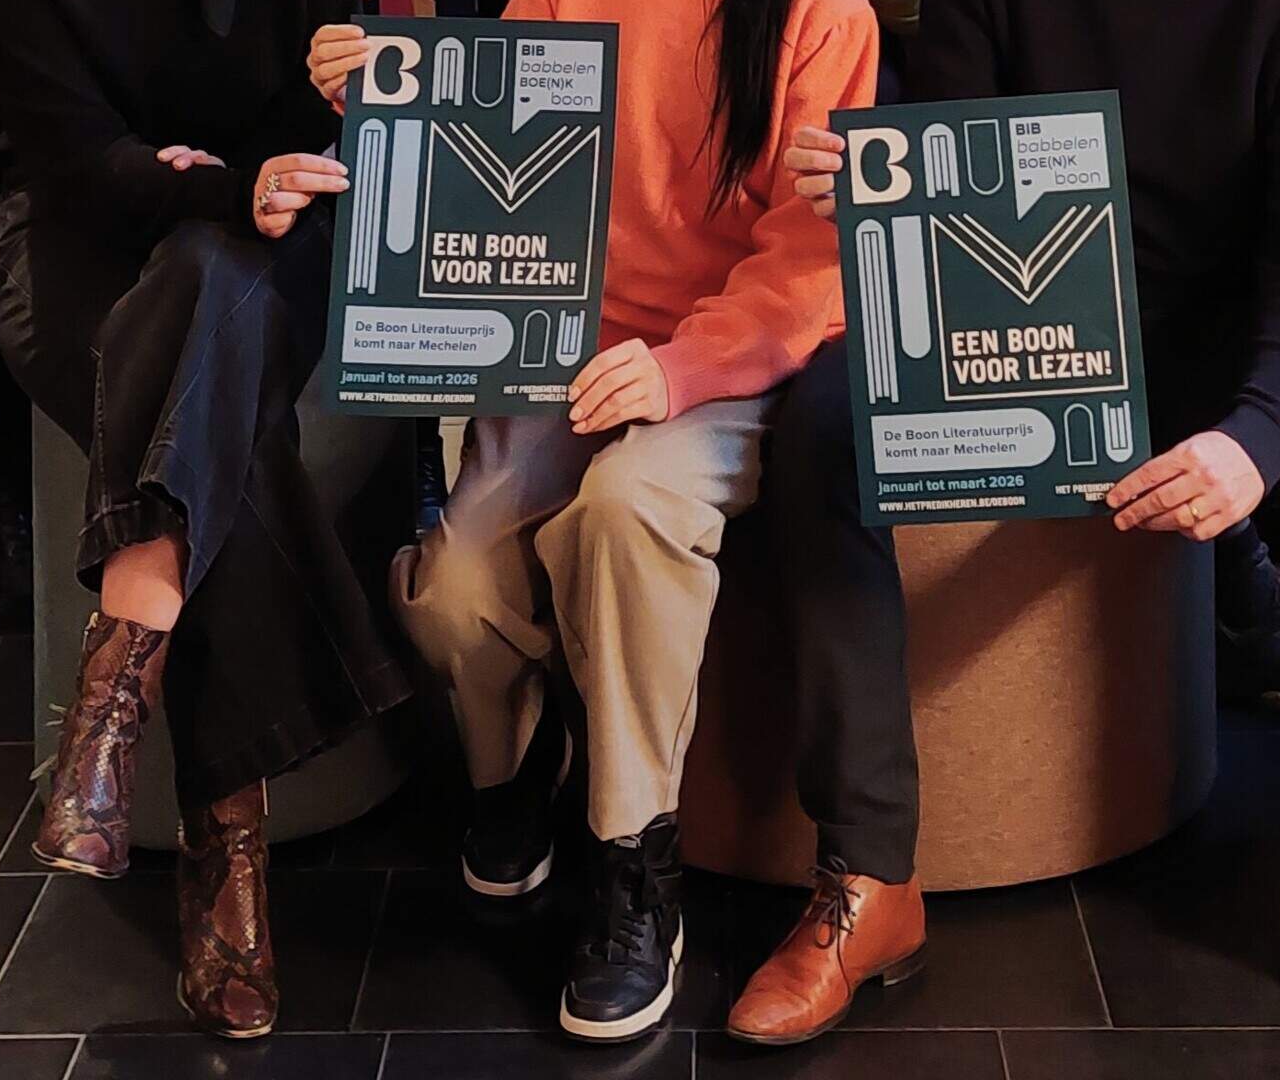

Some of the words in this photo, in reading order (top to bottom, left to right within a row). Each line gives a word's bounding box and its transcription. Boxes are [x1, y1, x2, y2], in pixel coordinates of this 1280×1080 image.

[521, 45, 545, 57] BIB
[520, 60, 596, 74] babbelen
[520, 76, 574, 91] BOE(N)K
[551, 92, 594, 106] boon
[1016, 122, 1042, 136] BIB
[1017, 136, 1099, 153] babbelen
[1018, 155, 1078, 170] BOE(N)K
[1054, 169, 1101, 186] boon
[432, 232, 477, 257] EEN
[485, 234, 547, 259] BOON
[431, 260, 492, 284] VOOR
[499, 261, 577, 286] LEZEN!
[355, 321, 372, 332] De
[376, 322, 408, 333] Boon
[411, 322, 495, 338] Literatuurprijs
[354, 338, 385, 350] komt
[388, 341, 416, 351] naar
[419, 340, 477, 352] Mechelen
[951, 331, 1000, 357] EEN
[1007, 324, 1075, 353] BOON
[952, 357, 1020, 384] VOOR
[1028, 350, 1112, 381] LEZEN!
[340, 370, 385, 385] januari
[387, 373, 405, 384] tot
[407, 374, 443, 385] maart
[445, 373, 479, 386] 2026
[884, 430, 902, 442] De
[906, 428, 939, 441] Boon
[943, 423, 1034, 439] Literatuurprijs
[885, 446, 918, 458] komt
[921, 446, 949, 457] naar
[954, 442, 1017, 455] Mechelen
[878, 480, 923, 496] januari
[926, 481, 945, 491] tot
[948, 478, 986, 490] maart
[988, 475, 1024, 488] 2026
